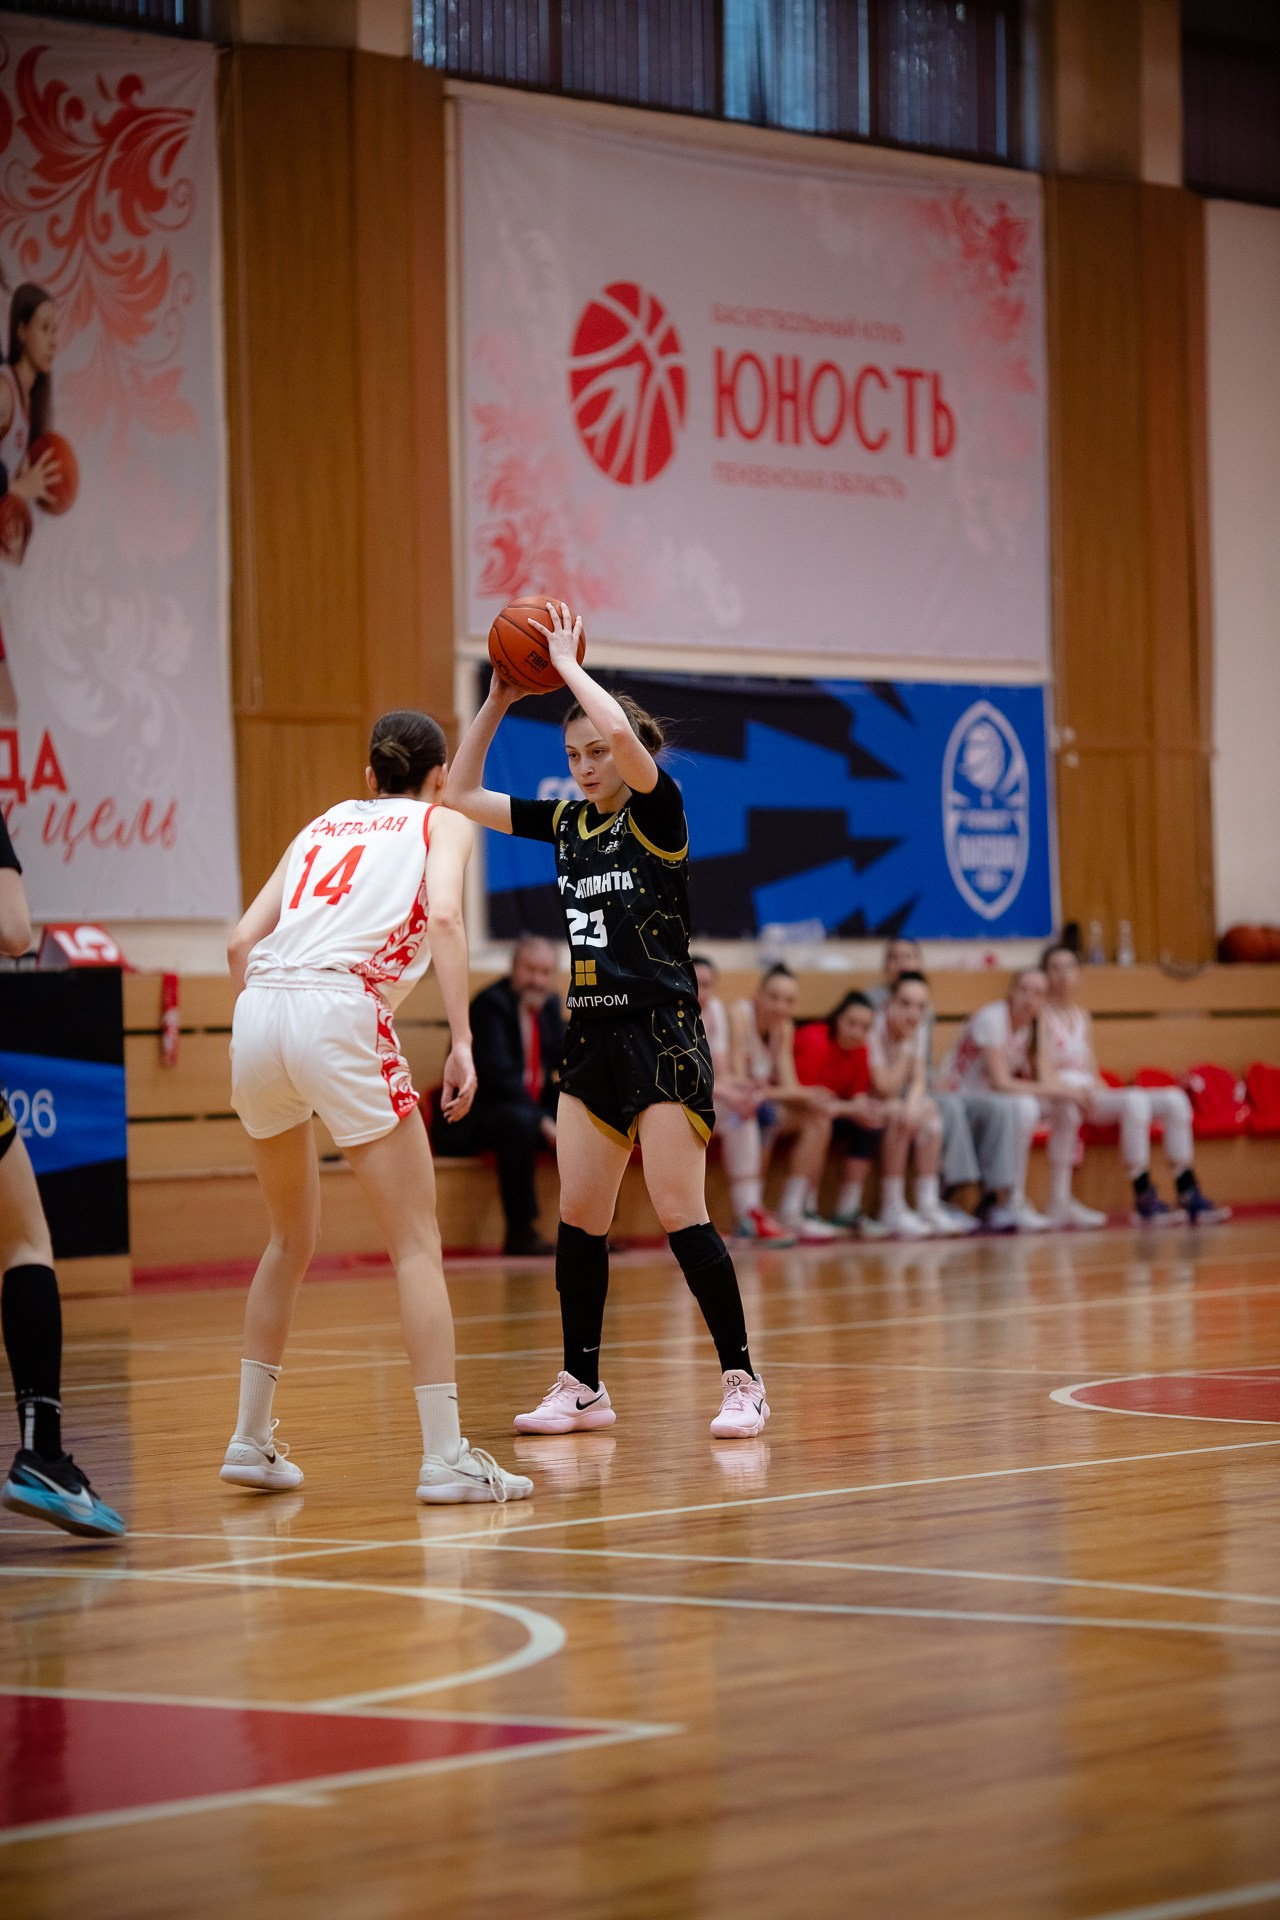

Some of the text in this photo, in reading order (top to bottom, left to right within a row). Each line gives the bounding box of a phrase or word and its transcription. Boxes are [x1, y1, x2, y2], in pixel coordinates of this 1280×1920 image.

[714, 347, 956, 459] ЮНОСТЬ
[527, 651, 549, 671] FIBA
[42, 796, 178, 864] цель
[288, 844, 367, 909] 14
[565, 908, 608, 948] 23
